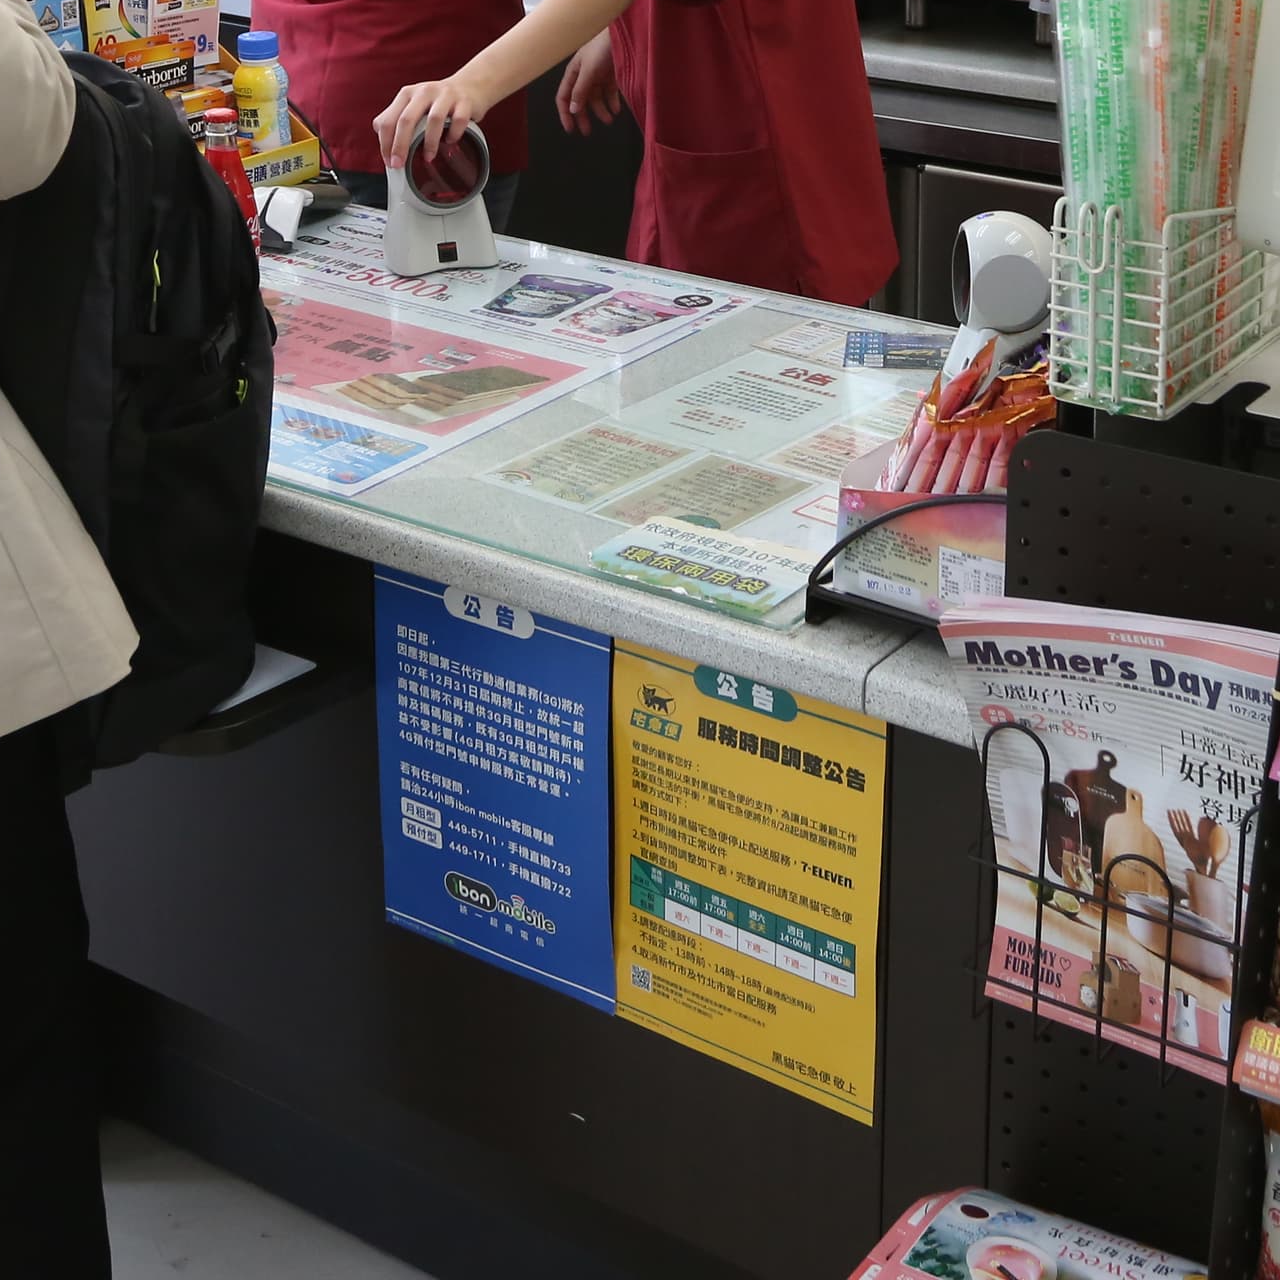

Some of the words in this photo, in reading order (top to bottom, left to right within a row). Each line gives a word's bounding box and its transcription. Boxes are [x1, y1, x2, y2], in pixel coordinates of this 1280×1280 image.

[779, 367, 837, 387] 公告
[618, 545, 771, 595] 環保兩用袋
[463, 594, 515, 630] 公告
[716, 672, 774, 713] 公告
[965, 640, 1137, 680] Mother's
[1150, 658, 1222, 711] Day
[980, 681, 1099, 714] 美麗好生活
[697, 716, 866, 793] 服務時間調整公告
[452, 878, 491, 907] ibon
[498, 900, 556, 934] mobile
